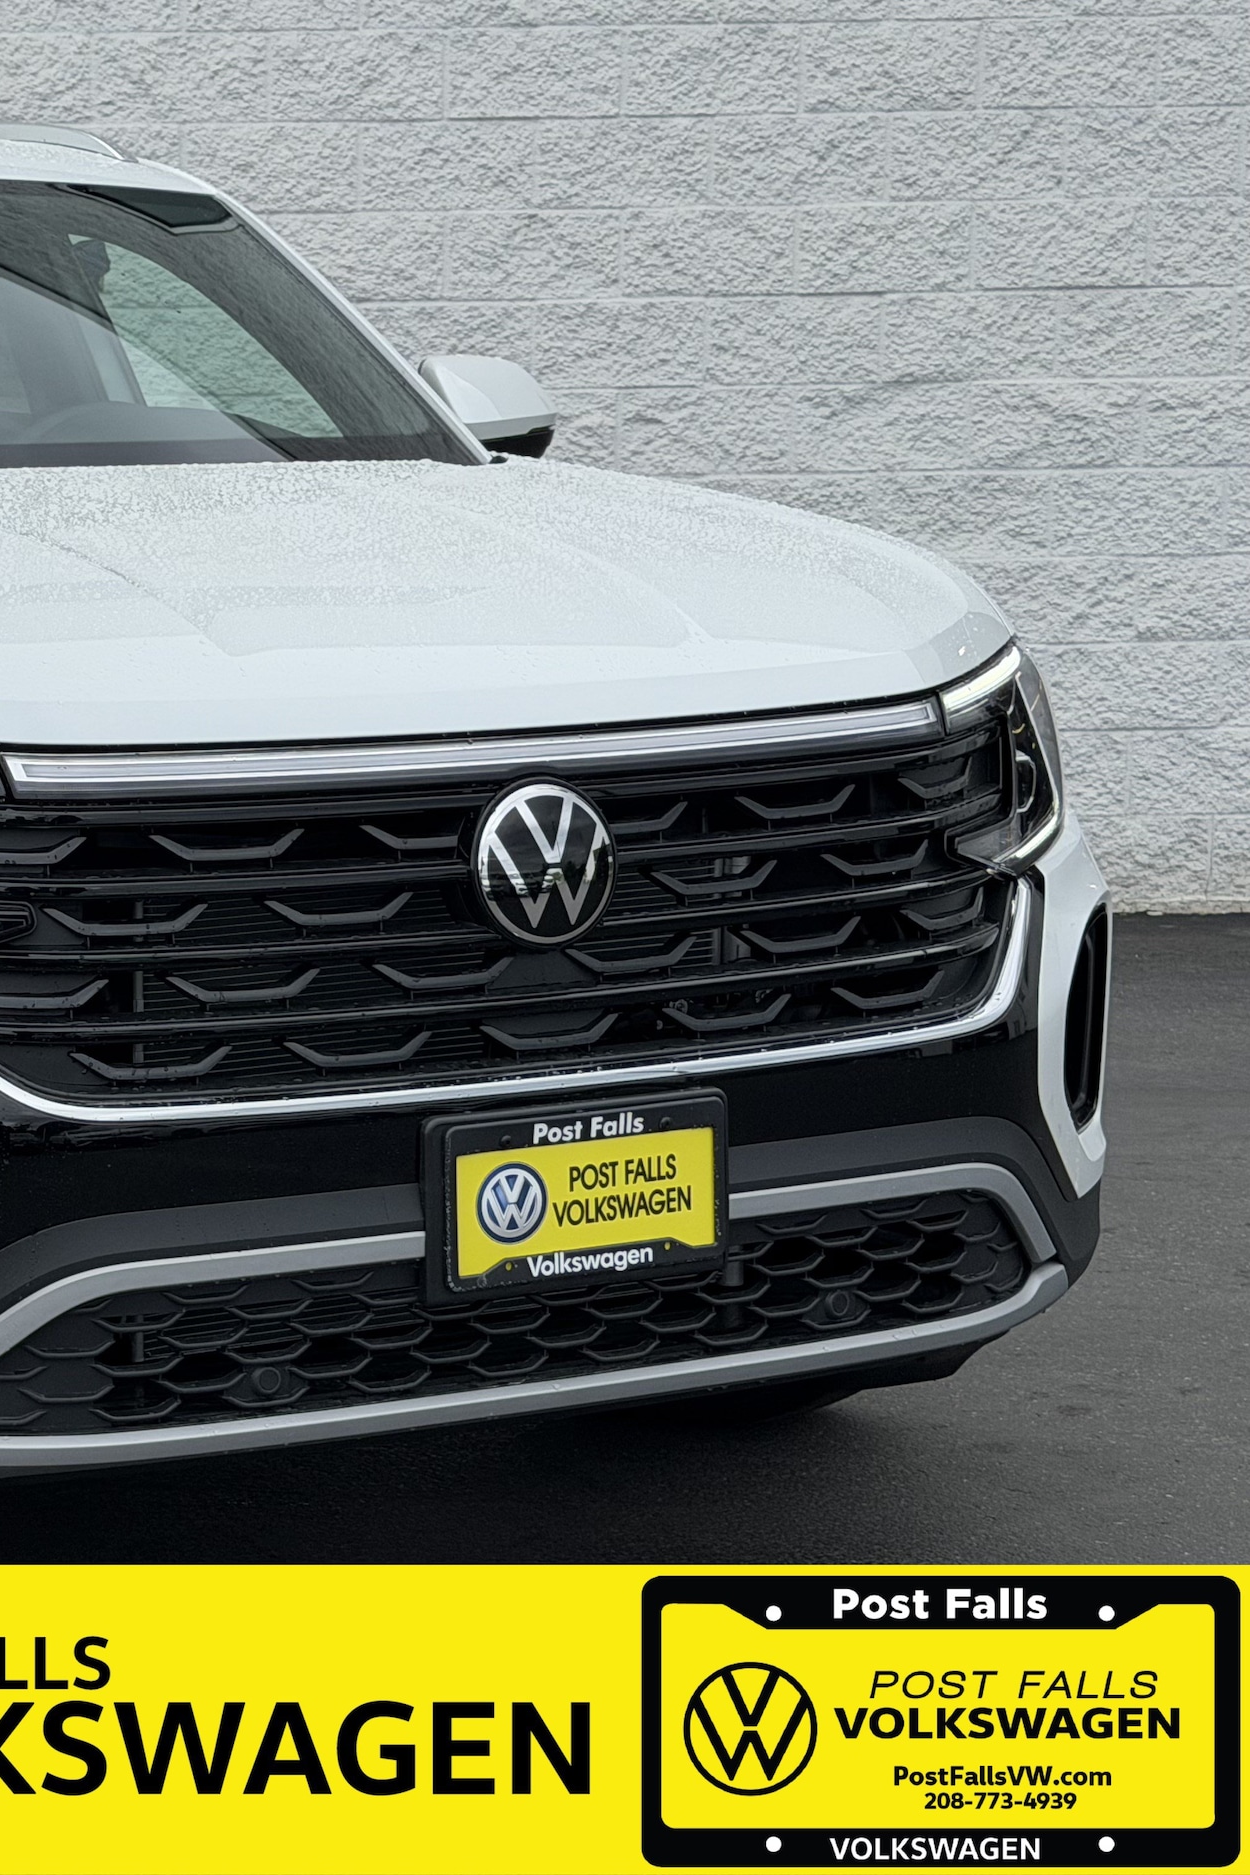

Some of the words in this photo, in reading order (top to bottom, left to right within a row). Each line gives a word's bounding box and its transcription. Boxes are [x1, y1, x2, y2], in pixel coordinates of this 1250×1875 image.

[532, 1120, 584, 1145] Post
[590, 1111, 645, 1138] Falls
[568, 1161, 619, 1193] POST
[624, 1153, 678, 1185] FALLS
[552, 1185, 693, 1228] VOLKSWAGEN
[526, 1246, 654, 1278] Volkswagen
